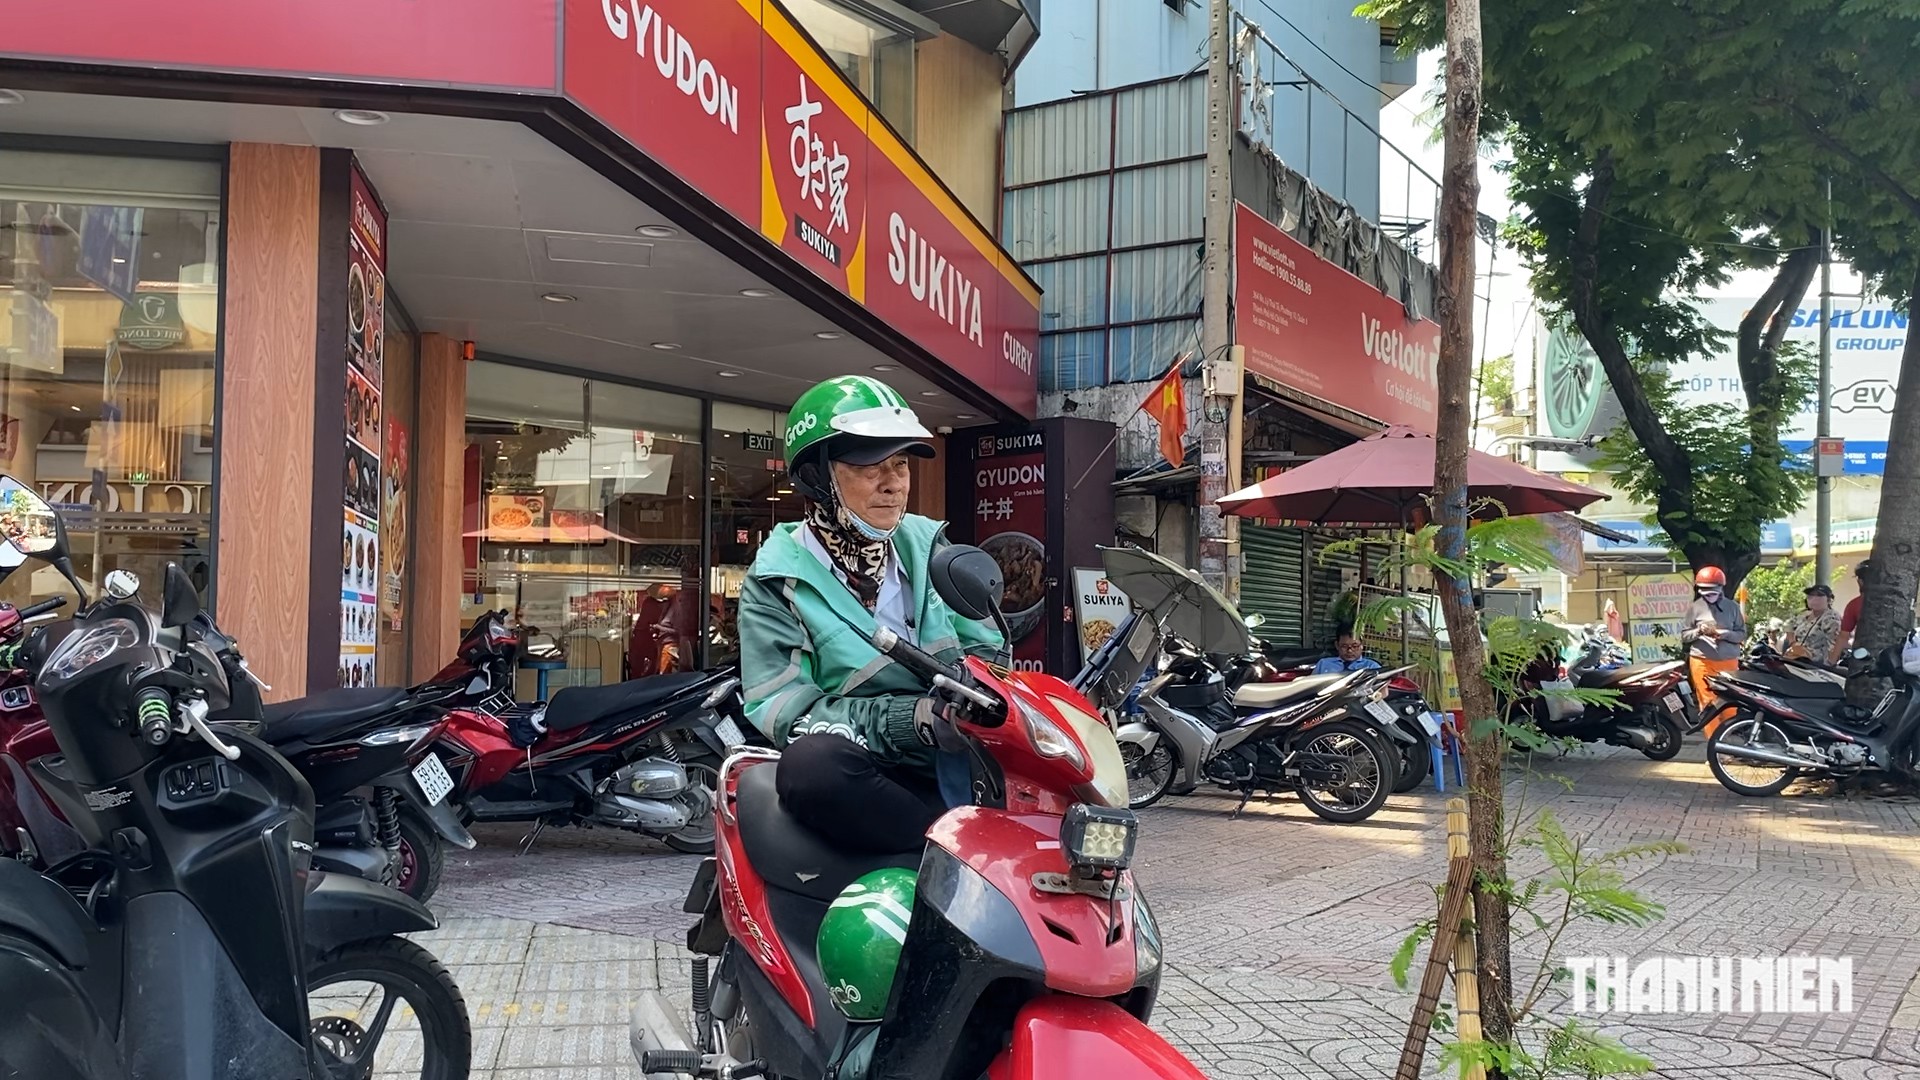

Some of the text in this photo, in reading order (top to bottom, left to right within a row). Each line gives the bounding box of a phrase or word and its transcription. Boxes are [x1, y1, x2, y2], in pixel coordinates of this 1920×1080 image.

[602, 0, 738, 135] GYUDON
[801, 221, 836, 263] SUKIYA
[888, 212, 983, 348] SUKIYA
[1790, 308, 1909, 329] SAILUN
[1003, 331, 1033, 376] CURRY
[1361, 312, 1426, 382] Vietlott
[1836, 338, 1903, 351] GROUP
[1718, 379, 1740, 392] TH
[1853, 387, 1886, 404] ev
[785, 411, 817, 447] Grab
[996, 433, 1043, 450] SUKIYA
[749, 435, 773, 450] EXIT
[976, 463, 1045, 488] GYUDON
[976, 496, 1014, 522] 牛丼
[1084, 594, 1124, 606] SUKIYA
[417, 758, 439, 784] 59-V3
[426, 772, 451, 801] 681.35
